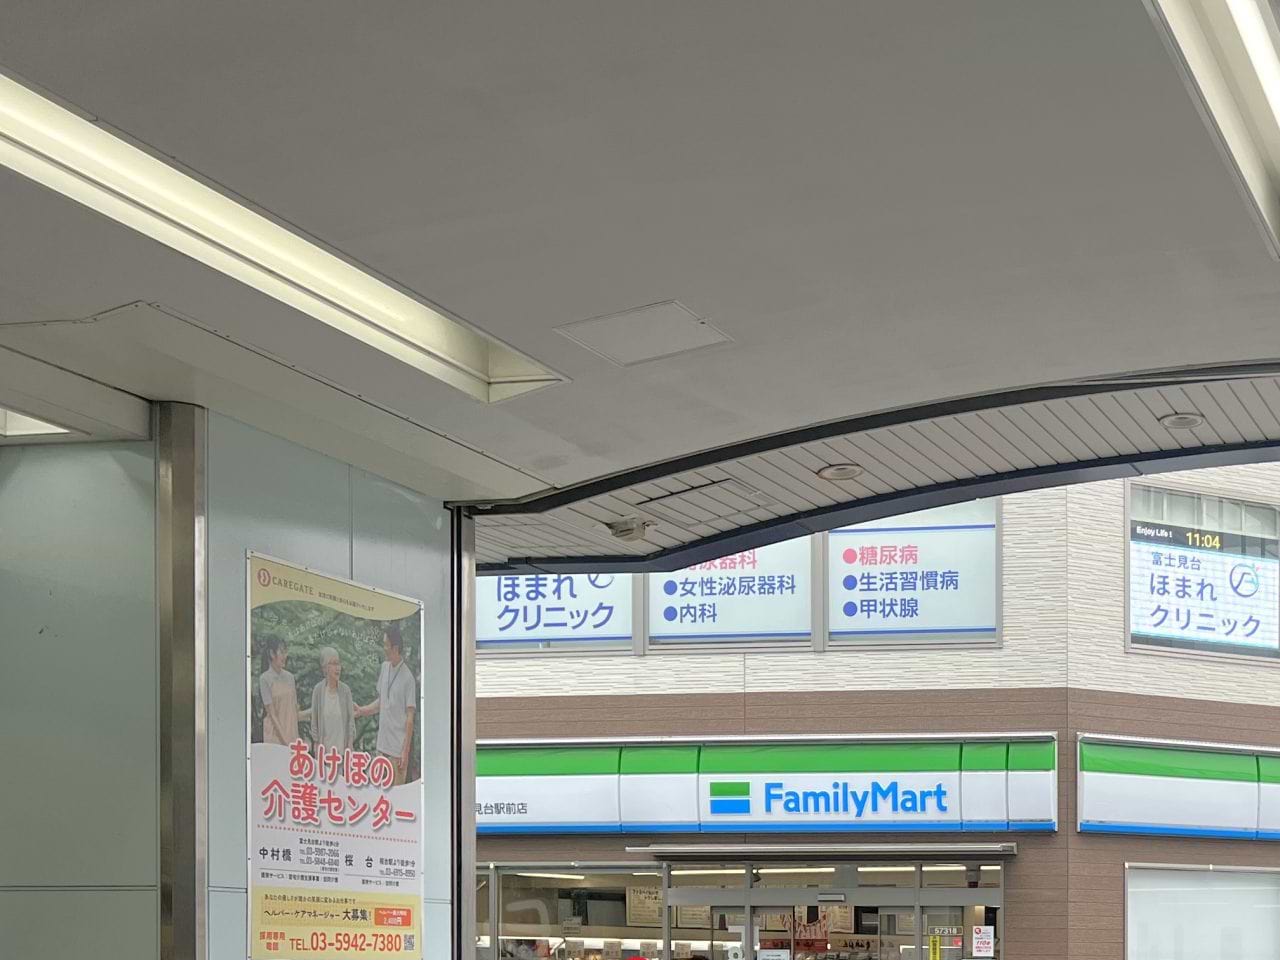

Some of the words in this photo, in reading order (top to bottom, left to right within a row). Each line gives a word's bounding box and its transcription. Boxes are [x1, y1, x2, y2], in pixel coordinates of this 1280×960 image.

[1136, 526, 1155, 536] Enjoy
[1186, 532, 1221, 549] 11:04
[859, 545, 918, 566] 糖尿病
[1152, 552, 1201, 570] 富士見台
[272, 577, 315, 596] CAREGATE
[497, 574, 577, 601] ほまれ
[679, 575, 796, 597] 女性泌尿器科
[859, 571, 959, 592] 生活習慣病
[1150, 573, 1217, 601] ほまれ
[497, 602, 614, 631] クリニック
[679, 603, 718, 623] 内科
[860, 598, 919, 619] 甲状腺
[1150, 605, 1260, 637] クリニック
[289, 739, 393, 788] あけぼの
[261, 779, 415, 828] 介護センター
[764, 782, 947, 818] FamilyMart
[259, 847, 292, 862] 中村橋
